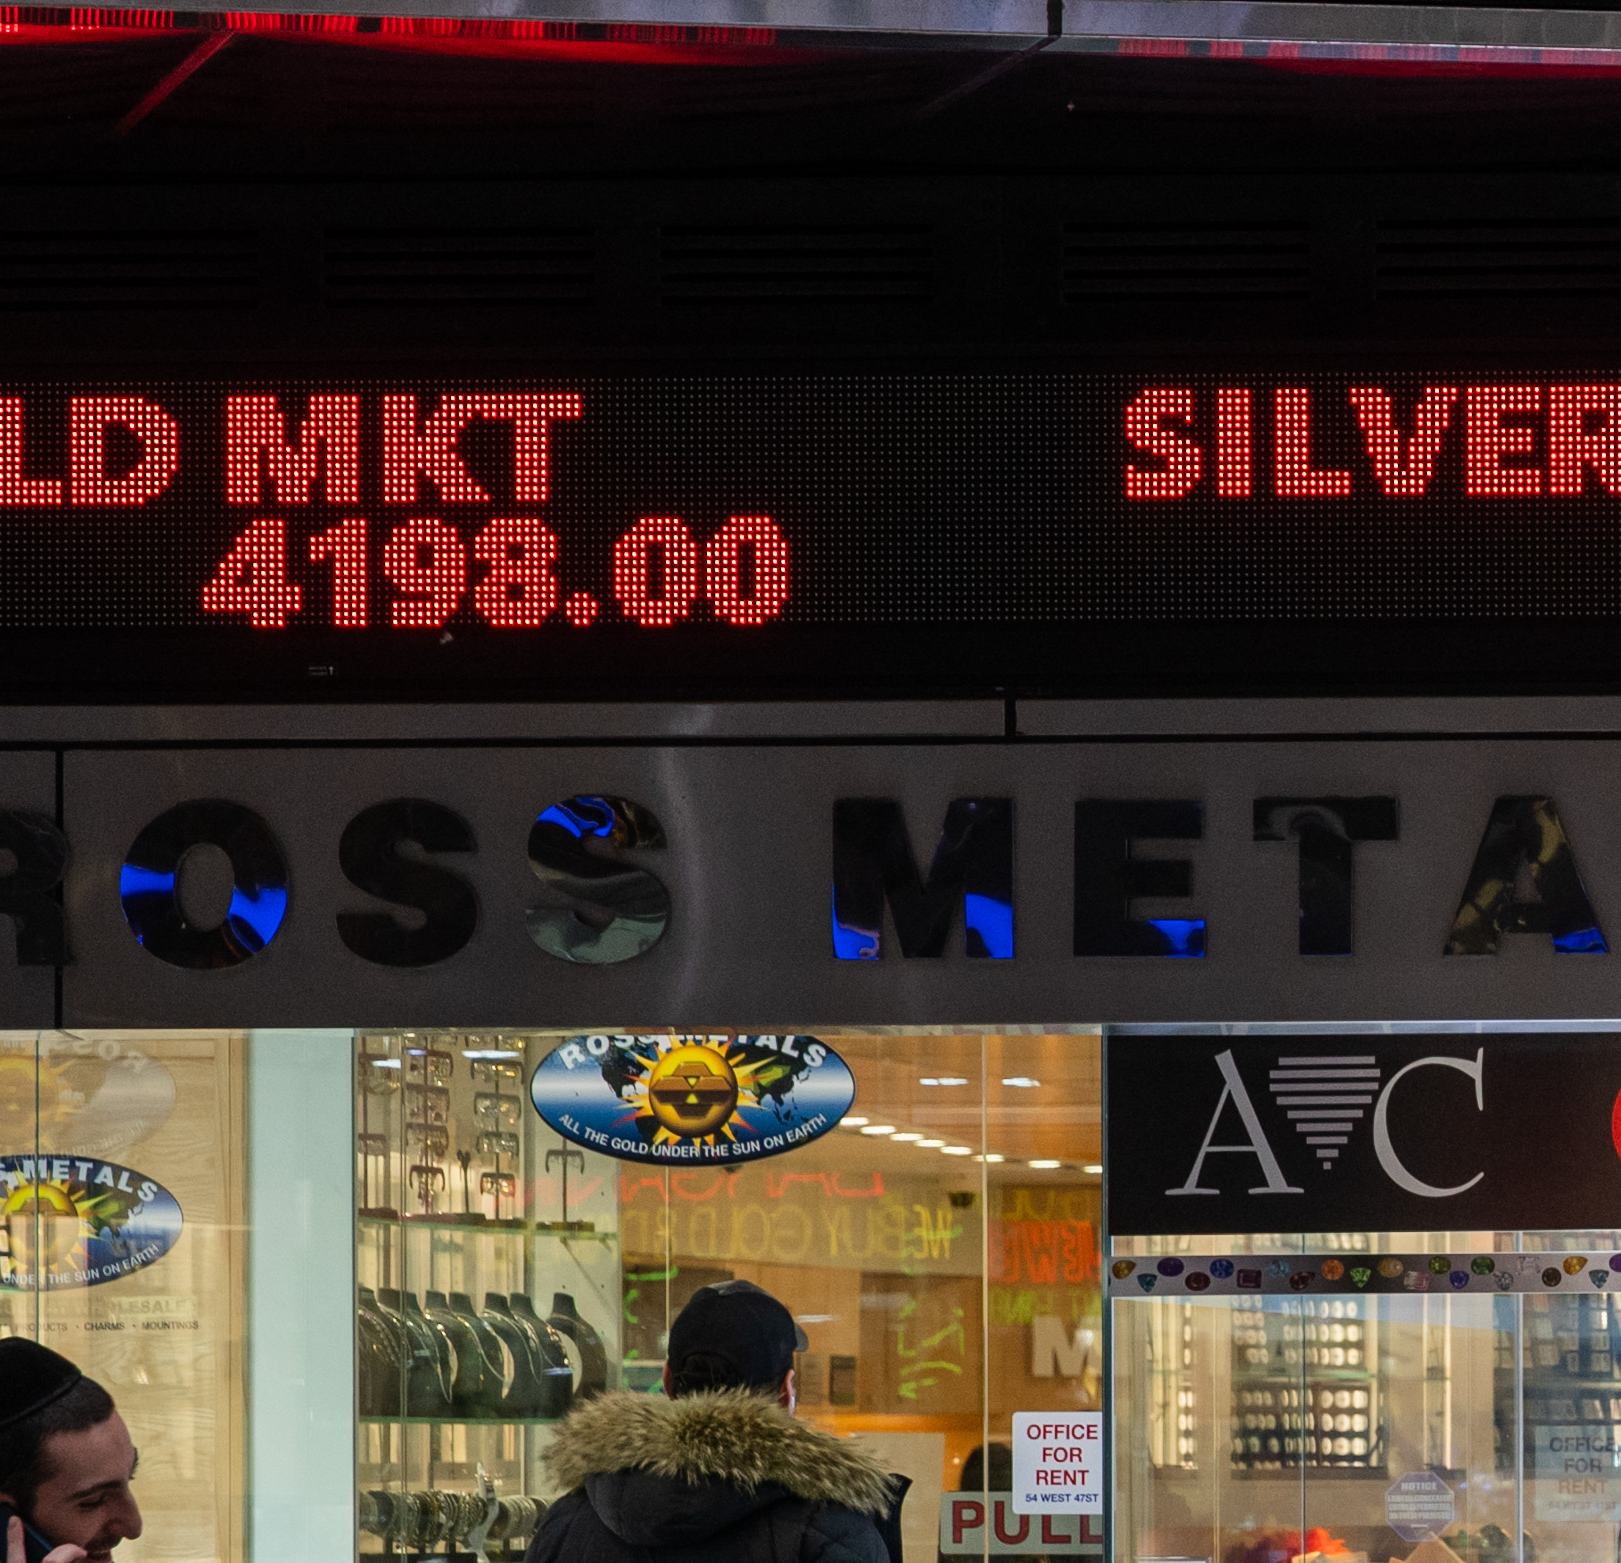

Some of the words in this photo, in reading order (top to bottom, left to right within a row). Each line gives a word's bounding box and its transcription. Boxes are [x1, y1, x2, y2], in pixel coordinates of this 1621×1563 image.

[226, 394, 583, 505] MKT
[203, 514, 790, 629] 4198.00
[558, 1113, 581, 1136] ALL
[583, 1126, 610, 1147] THE
[610, 1136, 649, 1155] GOLD
[652, 1144, 700, 1158] UNDER
[701, 1145, 729, 1158] THE
[732, 1140, 762, 1155] SUN
[763, 1133, 784, 1150] ON
[786, 1112, 828, 1144] EARTH
[22, 1158, 159, 1203] METALS
[48, 1272, 72, 1285] THE
[74, 1269, 101, 1283] SUN
[102, 1263, 121, 1276] ON
[121, 1243, 161, 1271] EARTH
[141, 1319, 199, 1331] MOUNTINGS
[1026, 1424, 1099, 1440] OFFICE
[1548, 1436, 1616, 1454] OFFICE
[1041, 1447, 1083, 1463] FOR
[1564, 1457, 1603, 1474] FOR
[1035, 1469, 1090, 1486] RENT
[1401, 1482, 1438, 1491] NOTICE
[1557, 1479, 1608, 1495] RENT
[1025, 1494, 1038, 1503] 54
[1041, 1493, 1072, 1503] WEST
[1073, 1493, 1099, 1503] 47ST
[952, 1500, 1103, 1544] PULL
